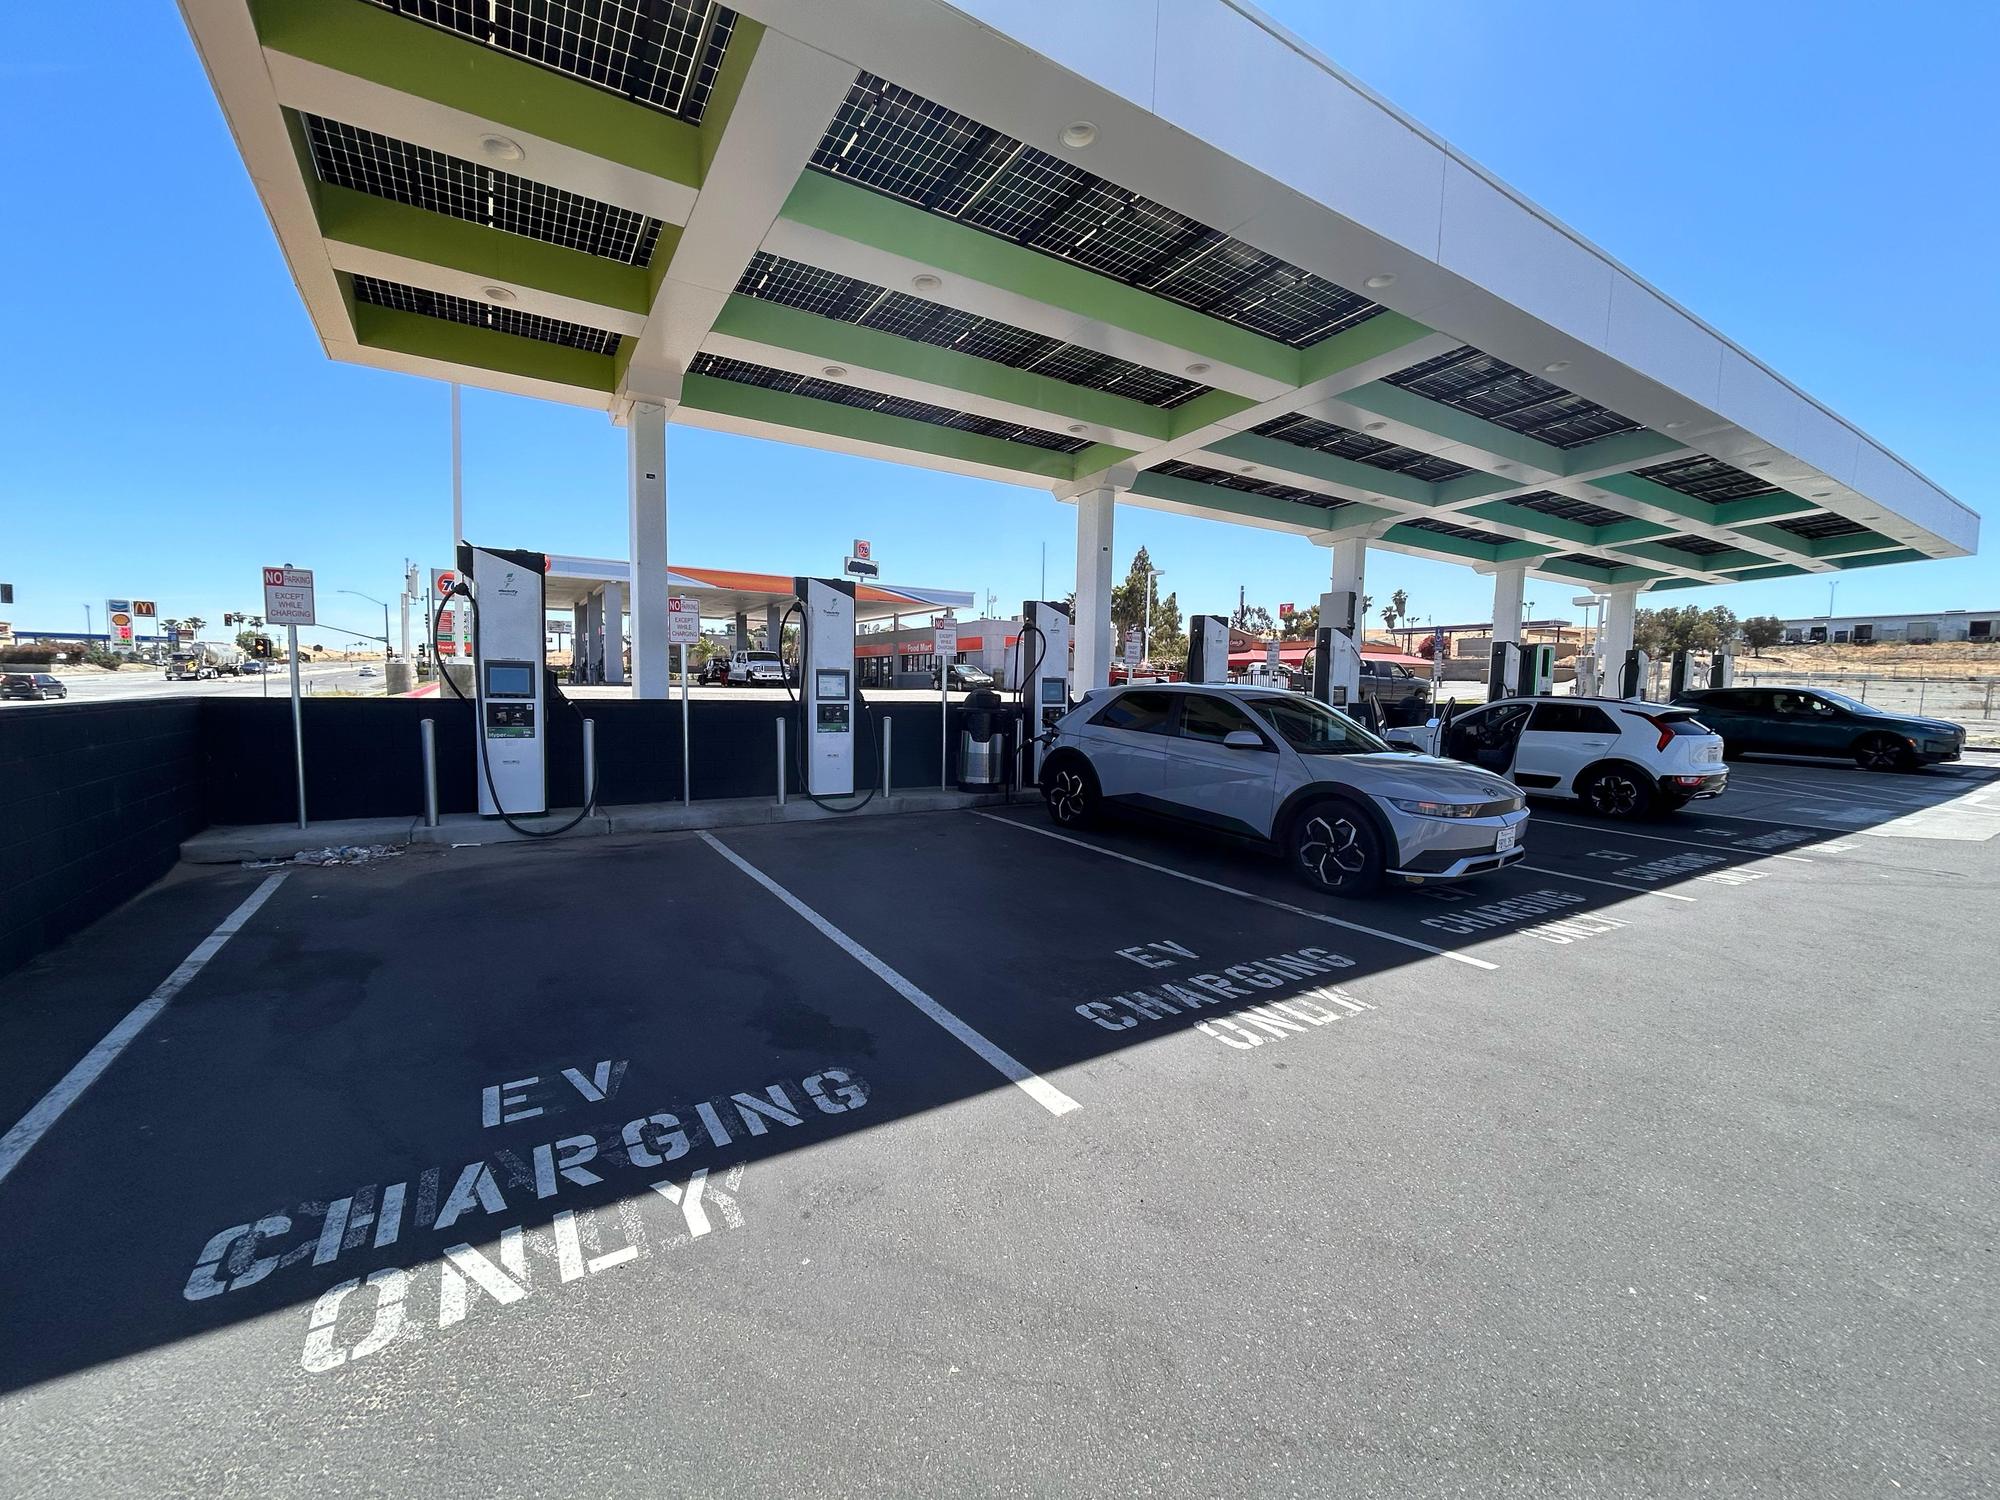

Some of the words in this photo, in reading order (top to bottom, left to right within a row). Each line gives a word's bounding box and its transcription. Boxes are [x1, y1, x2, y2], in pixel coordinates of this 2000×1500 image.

[265, 571, 283, 585] NO
[284, 574, 311, 585] PARKING
[274, 592, 305, 600] EXCEPT
[278, 601, 303, 609] WHILE
[670, 600, 680, 611] NO
[270, 609, 311, 618] CHARGING
[907, 644, 919, 652] Food
[920, 643, 932, 651] Mart
[1420, 889, 1587, 934] CHARGING
[1115, 940, 1200, 969] EV
[1075, 946, 1356, 1031] CHARGING
[482, 1060, 620, 1128] EV
[183, 1068, 870, 1301] CHARGING
[300, 1166, 720, 1374] ONLY
